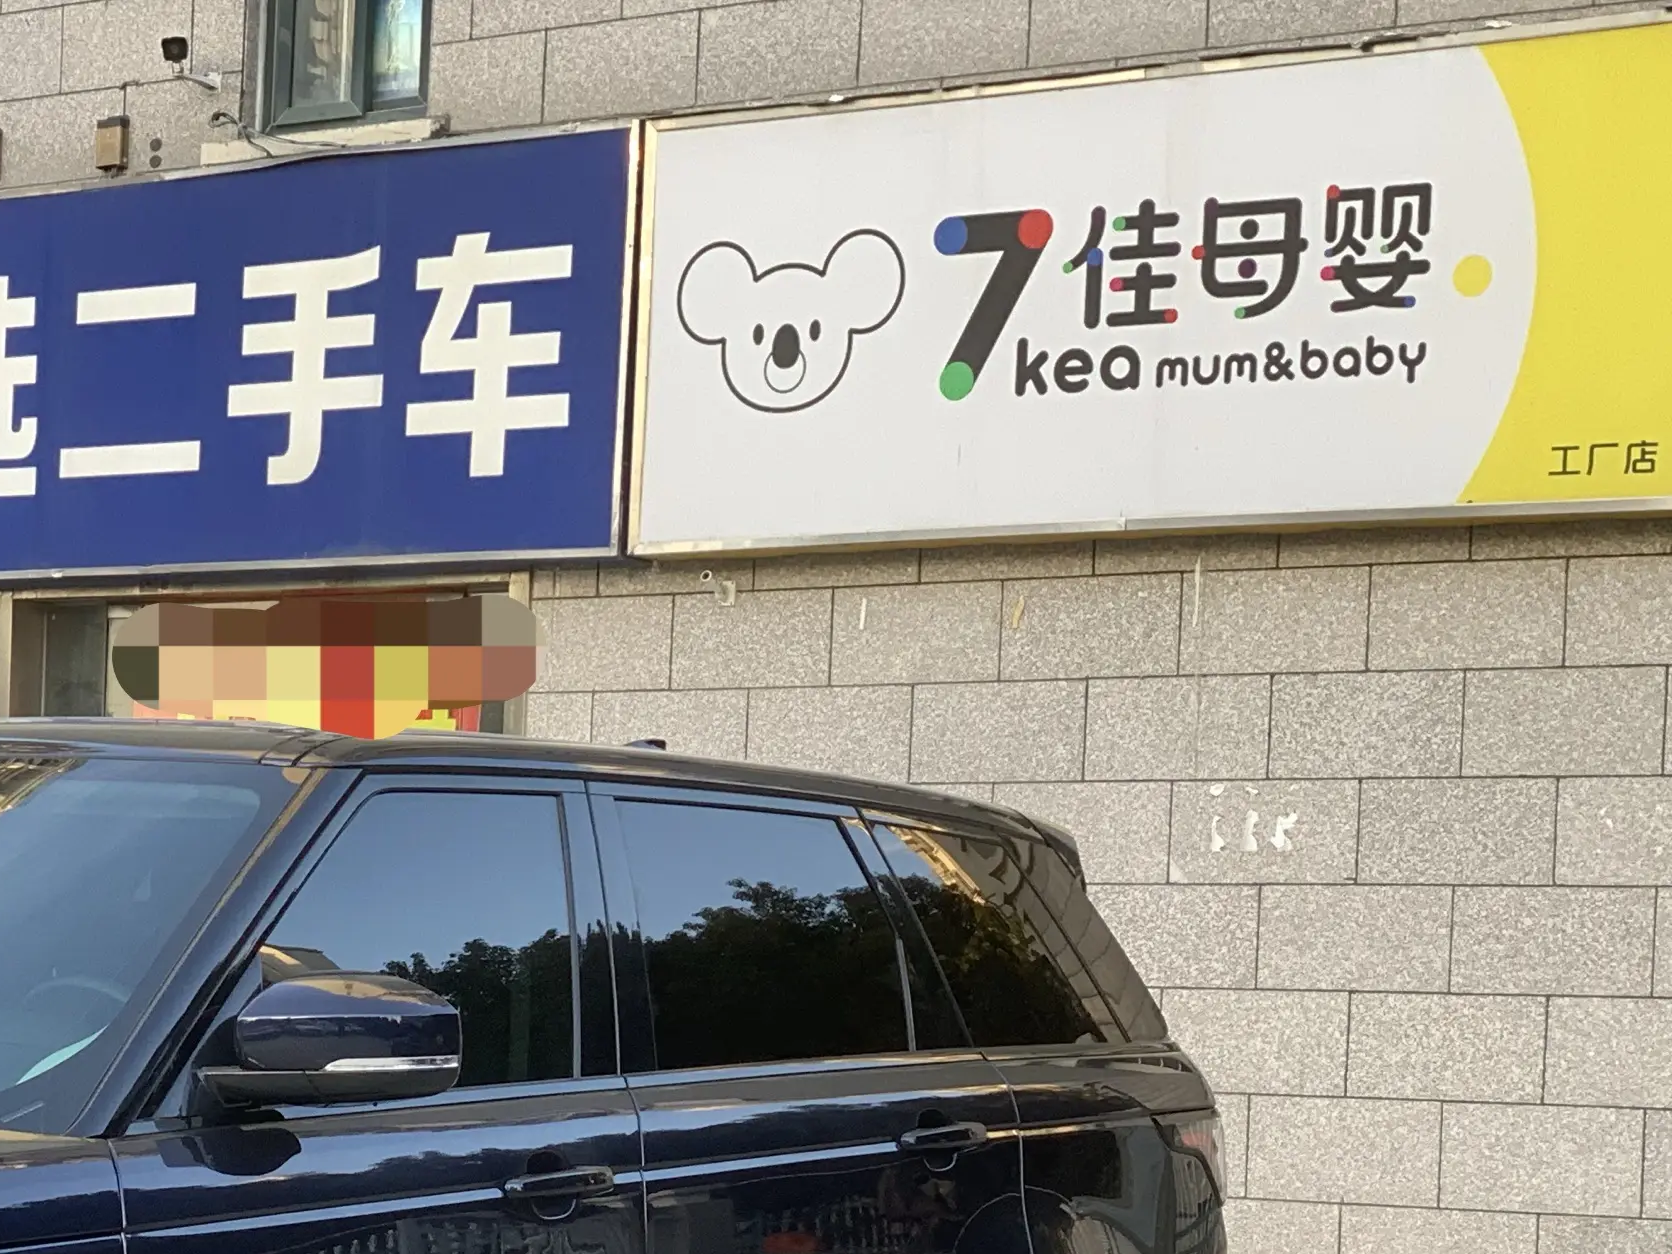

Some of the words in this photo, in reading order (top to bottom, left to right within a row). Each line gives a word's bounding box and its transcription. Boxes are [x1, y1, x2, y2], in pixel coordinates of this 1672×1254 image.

[1155, 335, 1428, 389] mum&baby
[1547, 439, 1659, 476] 工厂店
